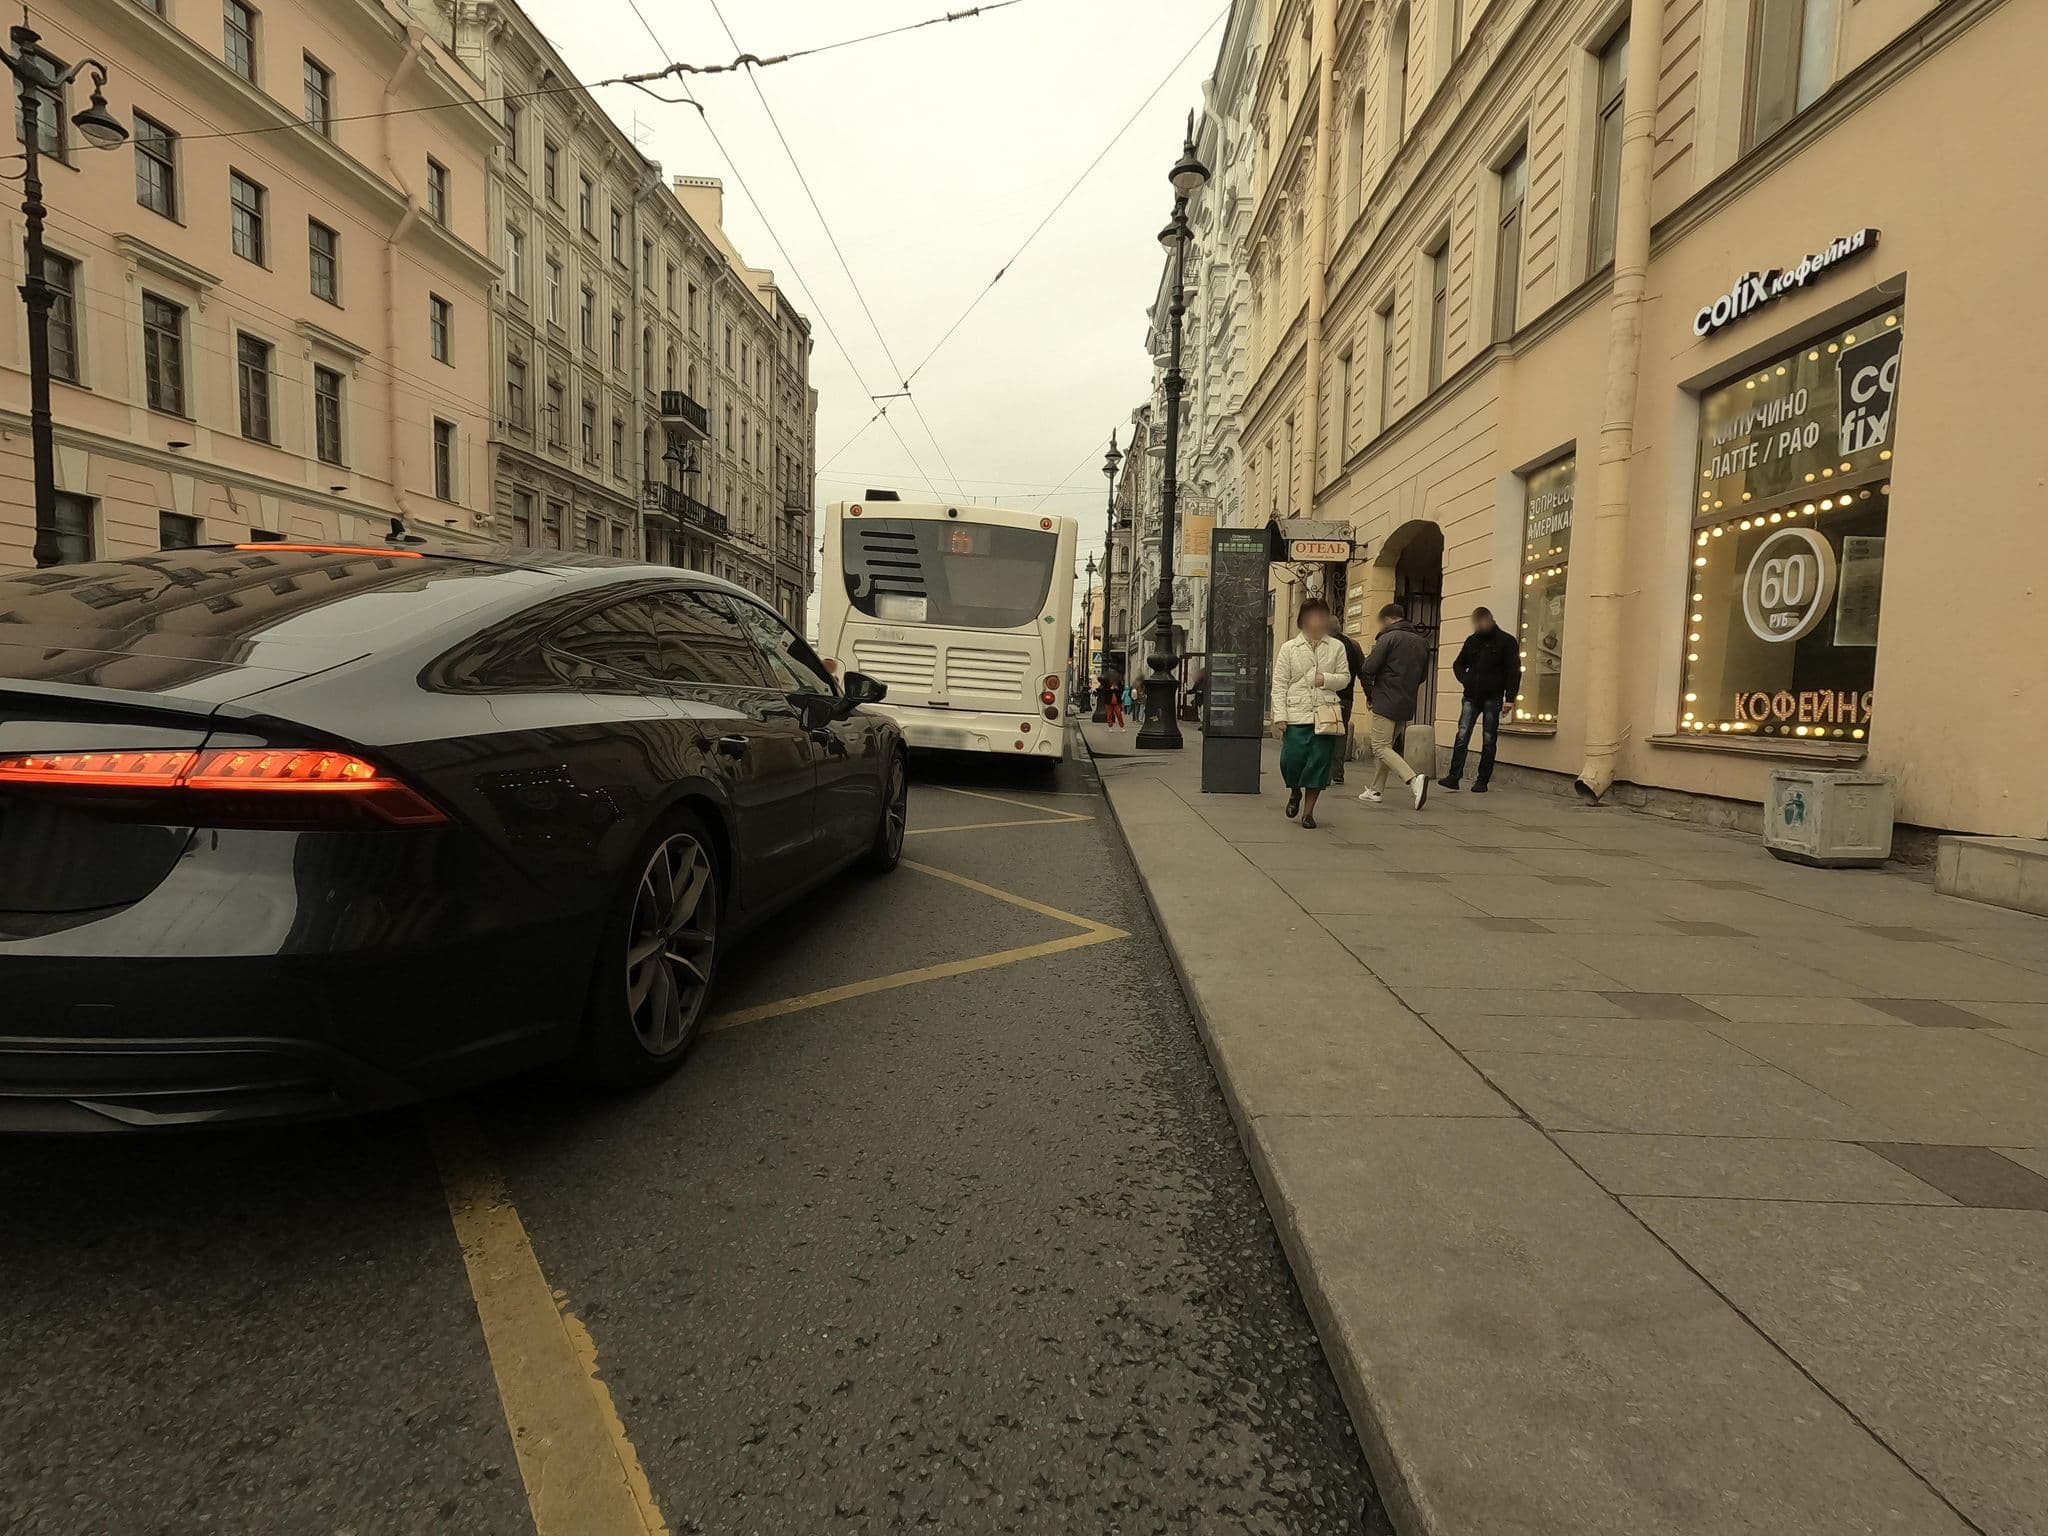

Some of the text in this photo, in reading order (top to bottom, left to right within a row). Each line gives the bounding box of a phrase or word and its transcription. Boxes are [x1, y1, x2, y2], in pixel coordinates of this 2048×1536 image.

[1693, 228, 1866, 337] cofix кофейня
[1709, 442, 1759, 481] ЛАТТЕ
[1778, 421, 1820, 459] РАФ
[1295, 542, 1346, 554] ОТЕЛЬ
[1760, 554, 1806, 609] 60
